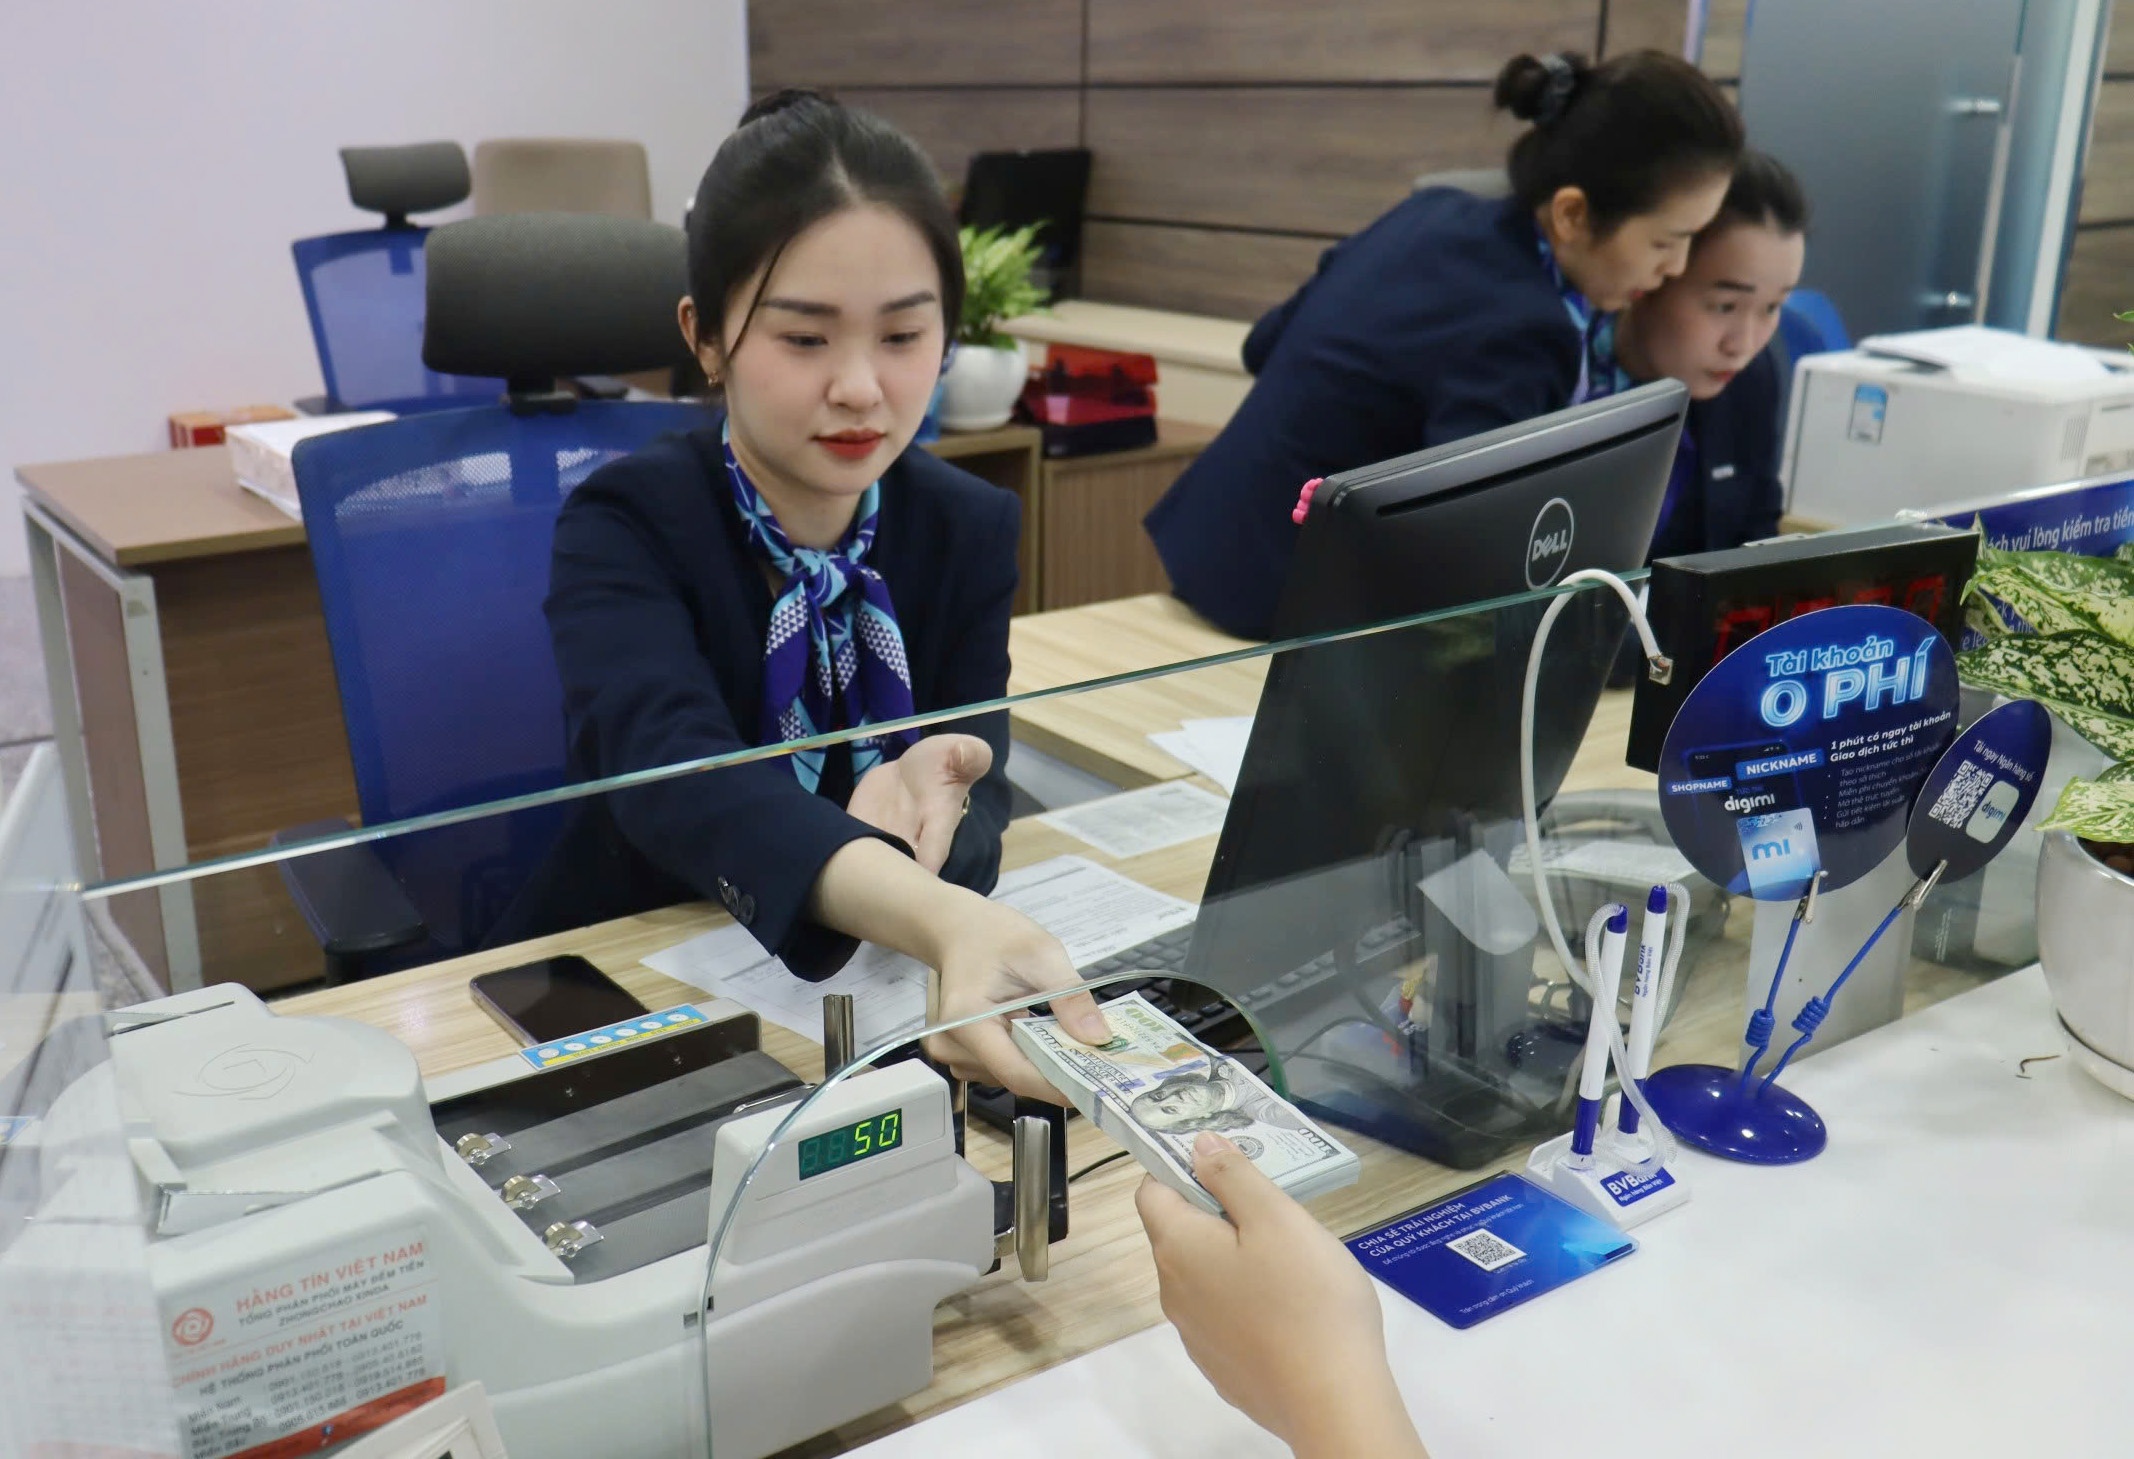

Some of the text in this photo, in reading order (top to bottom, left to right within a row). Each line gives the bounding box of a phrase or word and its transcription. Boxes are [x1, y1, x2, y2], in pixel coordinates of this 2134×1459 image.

[1532, 529, 1567, 562] DELL
[2012, 528, 2032, 552] vui
[2033, 526, 2060, 550] lòng
[2062, 514, 2092, 542] kiểm
[2094, 516, 2111, 534] tra
[1766, 636, 1893, 677] Tài khoản
[1823, 636, 1937, 719] PHÍ
[1831, 710, 1951, 750] 1 phút có ngay tài khoản
[1746, 752, 1818, 775] NICKNAME
[1830, 751, 1856, 762] Giao
[1858, 746, 1880, 758] dịch
[1882, 740, 1898, 750] tức
[1982, 747, 1999, 763] ngay
[1671, 780, 1728, 792] SHOPNAME
[854, 1114, 898, 1156] 50
[1358, 1236, 1386, 1250] CHIA
[1400, 1217, 1424, 1234] TRẢI
[1423, 1202, 1466, 1223] NGHIỆM
[1370, 1244, 1396, 1257] CỦA
[1418, 1218, 1456, 1238] KHÁCH
[1454, 1212, 1472, 1224] TẠI
[1470, 1194, 1513, 1214] BVBANK
[336, 1256, 377, 1280] VIỆT
[383, 1242, 424, 1266] NAM
